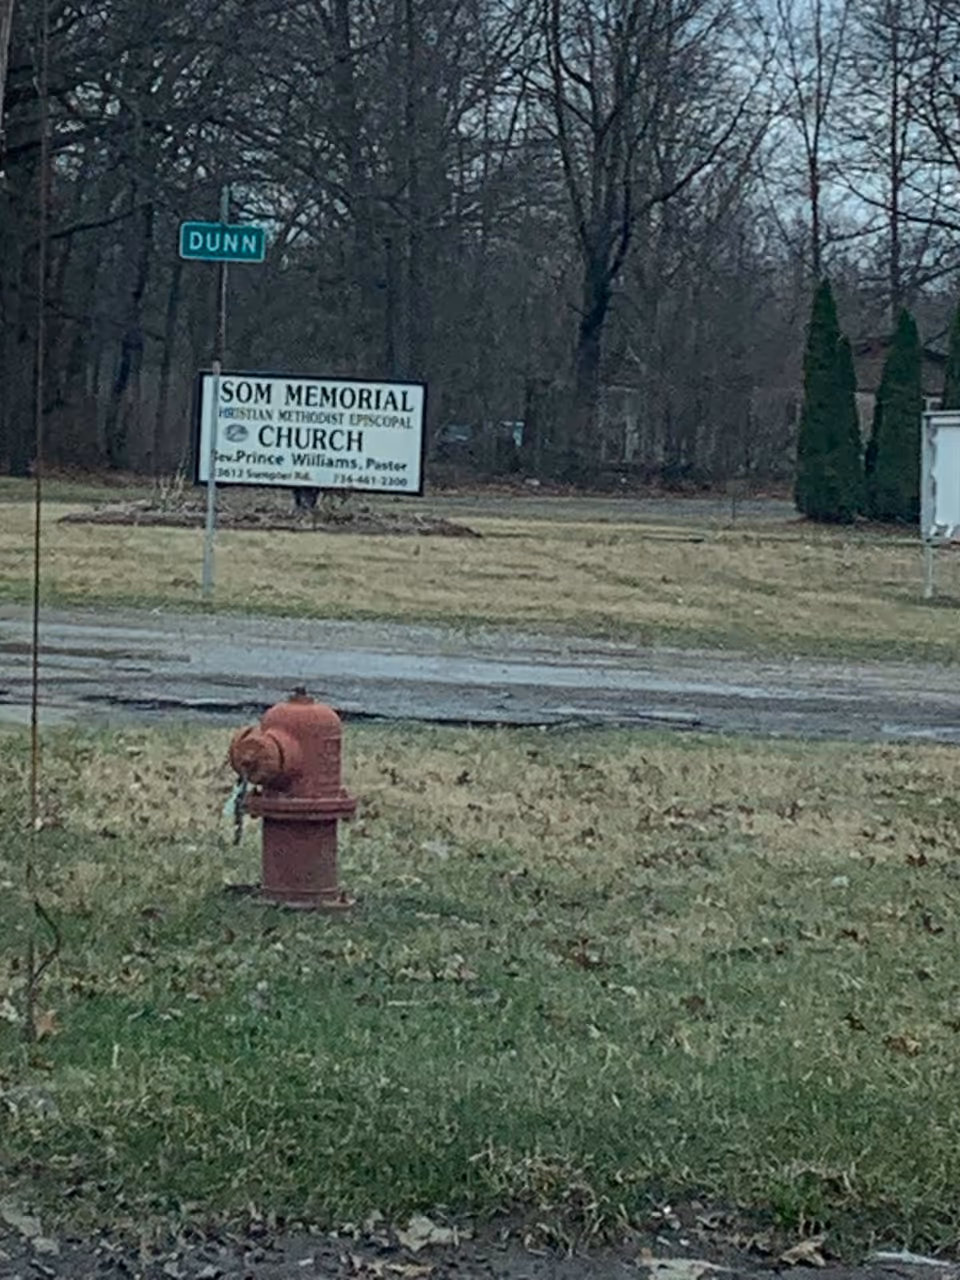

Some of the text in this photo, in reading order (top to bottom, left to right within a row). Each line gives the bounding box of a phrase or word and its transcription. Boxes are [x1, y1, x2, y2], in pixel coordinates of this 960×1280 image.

[189, 231, 257, 254] DUNN
[219, 380, 414, 412] SOM MEMORIAL
[218, 406, 414, 429] HRISTIAN METHODIST EPISCOPAL
[258, 425, 364, 452] CHURCH
[236, 450, 284, 466] Prince
[292, 453, 363, 471] Williams,
[366, 458, 408, 472] Pastor
